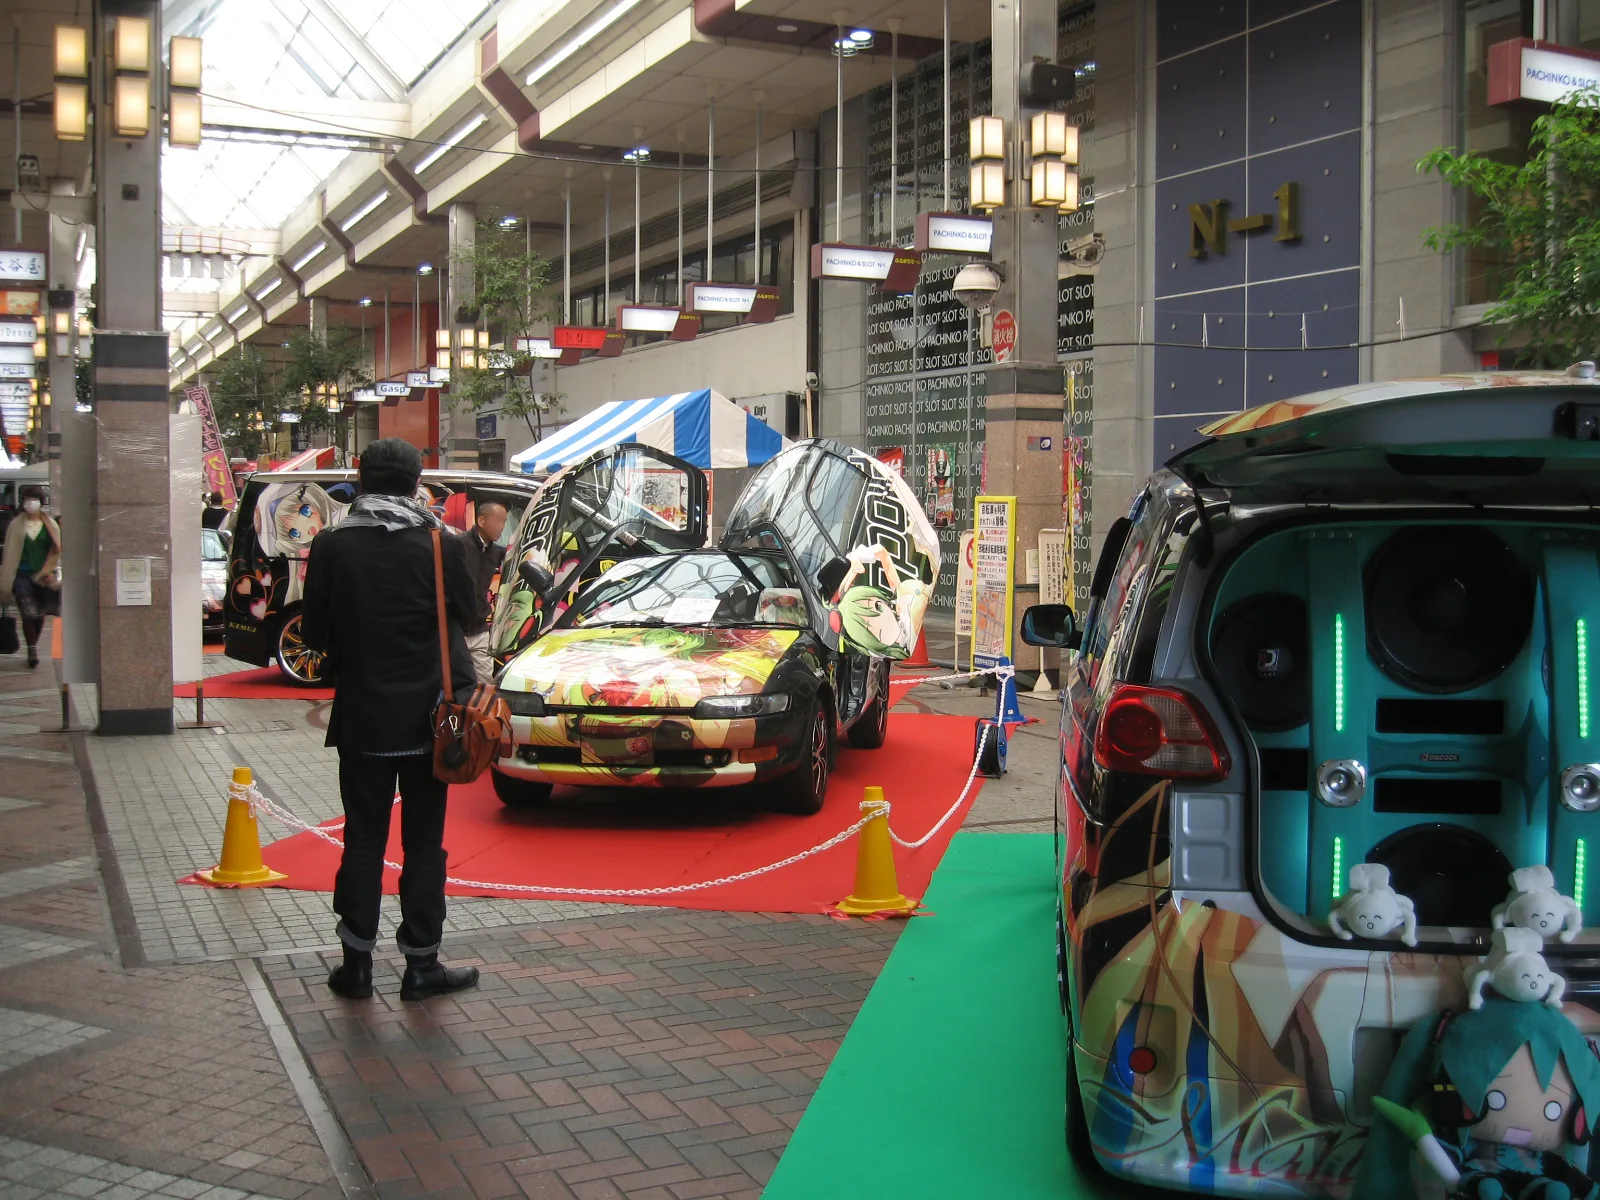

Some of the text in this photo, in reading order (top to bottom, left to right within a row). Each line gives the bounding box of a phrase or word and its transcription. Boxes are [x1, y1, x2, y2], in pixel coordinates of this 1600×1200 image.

[1526, 67, 1570, 85] PACHINKO
[1187, 181, 1304, 259] N-1
[933, 229, 967, 239] PACHINKO
[973, 232, 988, 240] SLOT
[0, 258, 41, 275] 谷屋
[826, 258, 857, 266] PACHINKO
[697, 294, 725, 303] PACHINKO
[1058, 283, 1095, 303] LOT SLOT
[880, 320, 894, 333] SLOT
[894, 317, 909, 330] SLOT
[926, 312, 942, 326] SLOT
[993, 327, 1014, 345] 消火栓
[894, 358, 909, 372] SLOT
[926, 355, 942, 369] SLOT
[942, 353, 958, 367] SLOT
[977, 348, 993, 362] SLOT
[380, 384, 406, 395] Gasp
[927, 375, 961, 391] PACHINKO
[1075, 385, 1094, 400] SLOT
[879, 404, 893, 417] SLOT
[893, 402, 909, 416] SLOT
[925, 399, 941, 413] SLOT
[941, 398, 957, 412] SLOT
[927, 419, 961, 434] PACHINKO
[981, 504, 1006, 515] 自転車を利用
[940, 530, 957, 543] SLOT
[1073, 537, 1092, 550] SLOT
[940, 573, 956, 586] SLOT
